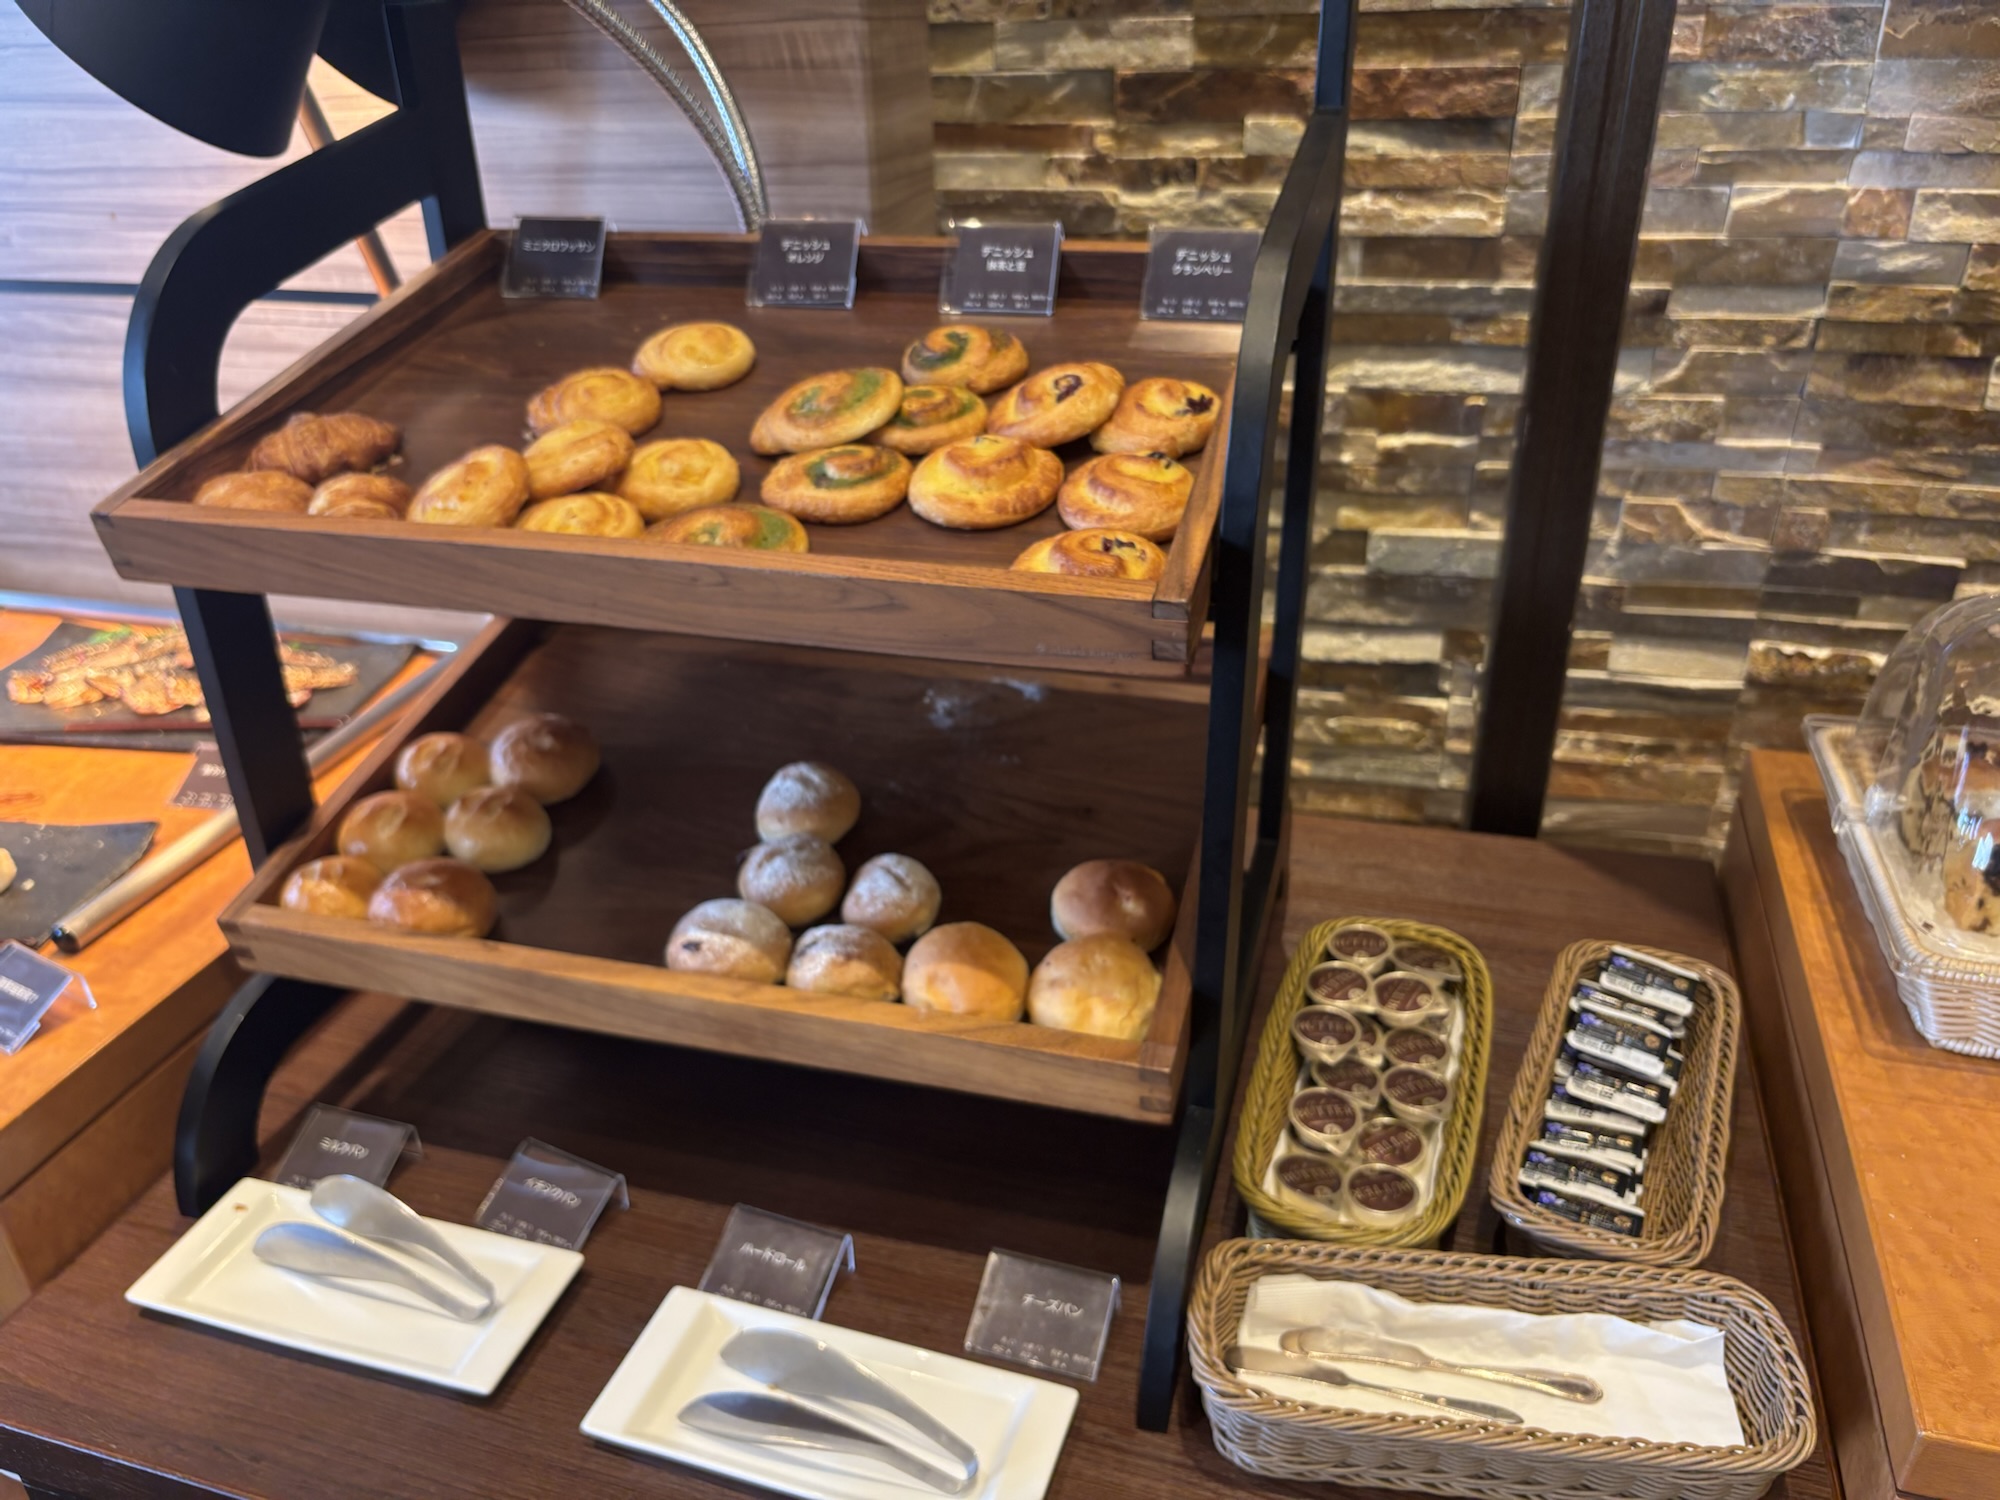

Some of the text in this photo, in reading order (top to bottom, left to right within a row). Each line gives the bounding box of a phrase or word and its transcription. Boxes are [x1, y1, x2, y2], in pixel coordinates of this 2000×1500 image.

[522, 240, 596, 253] ミニクロワッサン
[781, 239, 831, 252] デニッシュ
[981, 245, 1034, 259] デニッシュ
[786, 252, 825, 264] オレンジ
[1175, 249, 1232, 263] デニッシュ
[1172, 263, 1233, 277] クランベリー
[320, 1137, 369, 1159] ミルクパン
[739, 1242, 806, 1272] ハードロール
[1022, 1294, 1084, 1318] チーズパン
